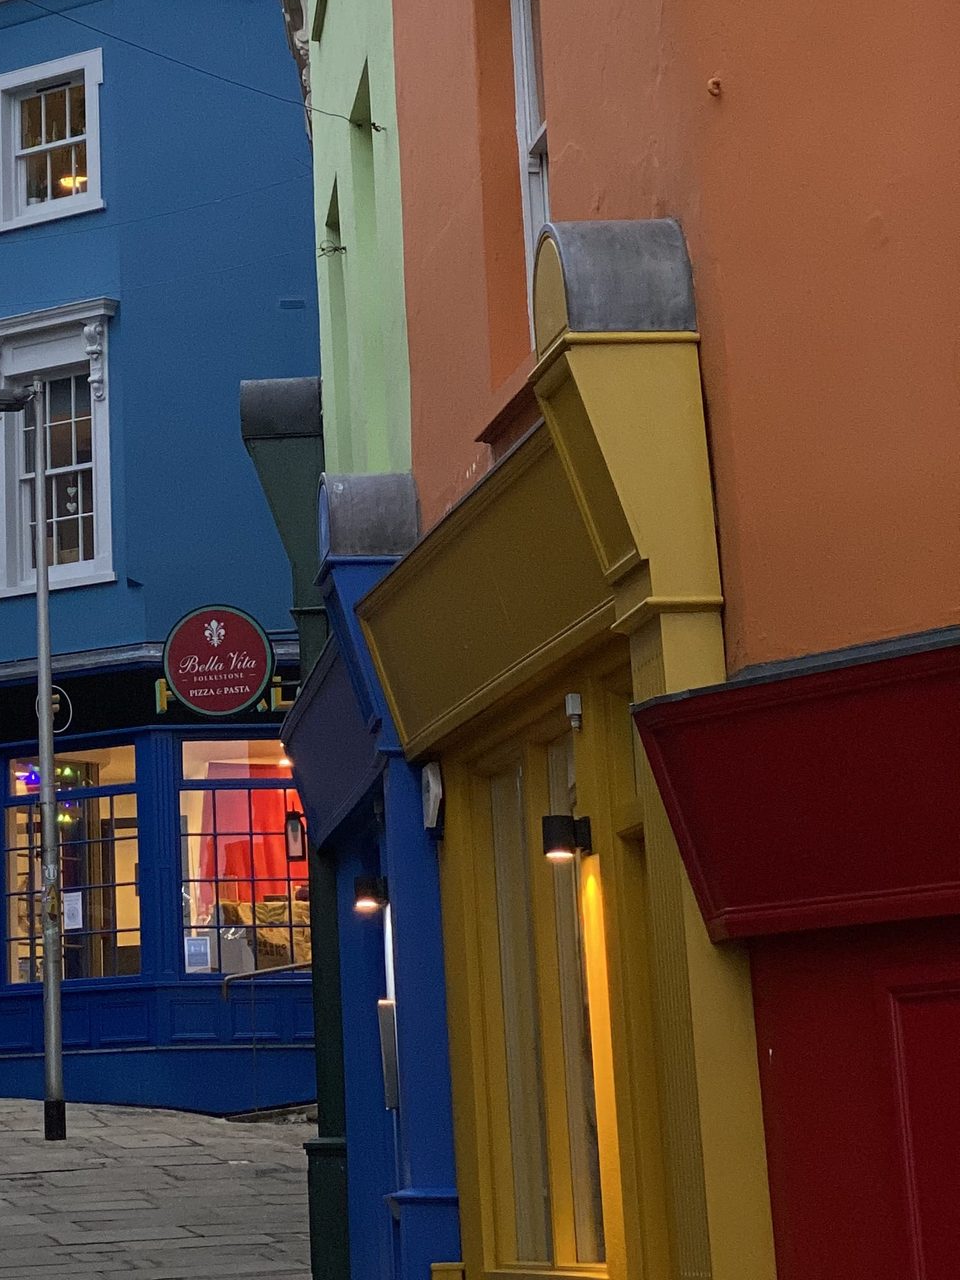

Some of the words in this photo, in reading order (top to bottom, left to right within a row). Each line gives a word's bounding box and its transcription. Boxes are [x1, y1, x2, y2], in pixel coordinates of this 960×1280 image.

[179, 655, 224, 673] Bella
[227, 651, 257, 670] Vita
[193, 673, 244, 682] FOLKESTONE
[189, 688, 215, 697] PIZZA
[224, 685, 250, 694] PASTA
